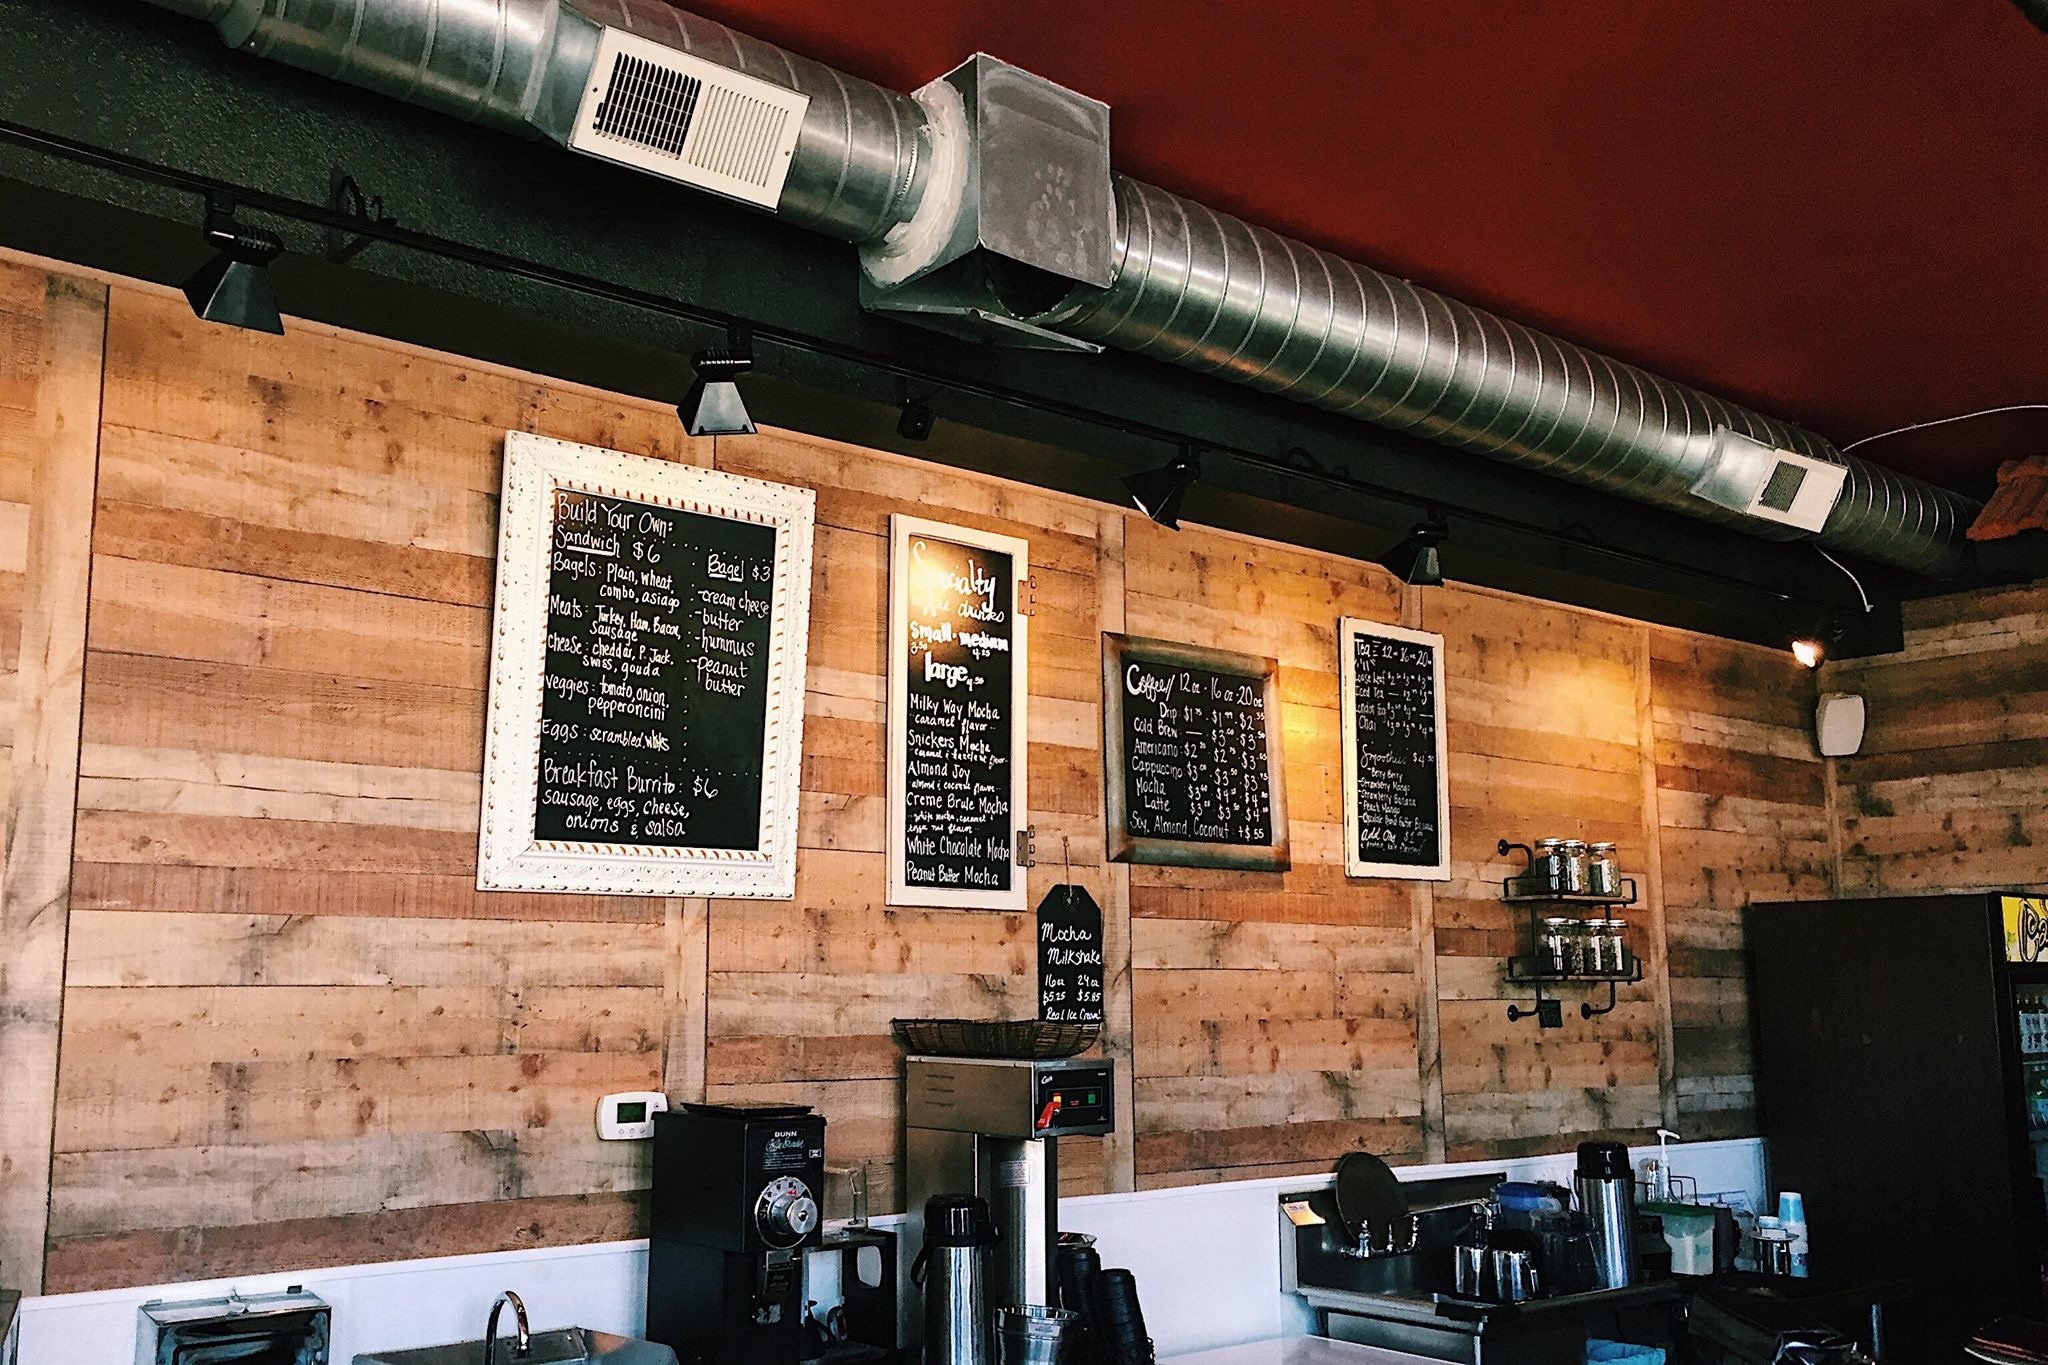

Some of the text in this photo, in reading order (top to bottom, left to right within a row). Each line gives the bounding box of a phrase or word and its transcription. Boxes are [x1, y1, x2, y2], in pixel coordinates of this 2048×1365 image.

[557, 493, 598, 524] Build
[601, 503, 634, 531] Your
[556, 525, 660, 563] Sandwich $6
[708, 554, 770, 582] Bagel $3
[913, 541, 996, 612] Scialty
[600, 585, 680, 613] combo, asiago
[738, 590, 769, 618] cheese
[958, 600, 1004, 622] drinks
[910, 620, 951, 643] Small
[621, 662, 660, 679] gouda
[925, 651, 968, 688] large
[705, 674, 745, 697] butter
[588, 696, 666, 720] pepperoncini
[910, 693, 1000, 720] Milky Way Mocha
[1134, 717, 1152, 734] Cold
[908, 729, 991, 754] Snickers Mocha
[544, 758, 618, 790] Breakfast
[693, 775, 718, 799] $6
[908, 760, 970, 784] Almond Joy
[1136, 777, 1166, 796] Mocha
[607, 797, 639, 818] eggs,
[906, 792, 1008, 815] Creme Brule Mocha
[1145, 796, 1170, 812] Latte
[566, 814, 619, 833] onions
[645, 818, 686, 837] salsa
[1194, 817, 1229, 839] Coconut
[907, 835, 1009, 861] White Chocolate Mocha
[906, 860, 998, 886] Peanut Butter Mocha
[1041, 922, 1092, 942] Mocha
[1047, 948, 1101, 965] Milkshake
[1067, 1009, 1077, 1020] Ice
